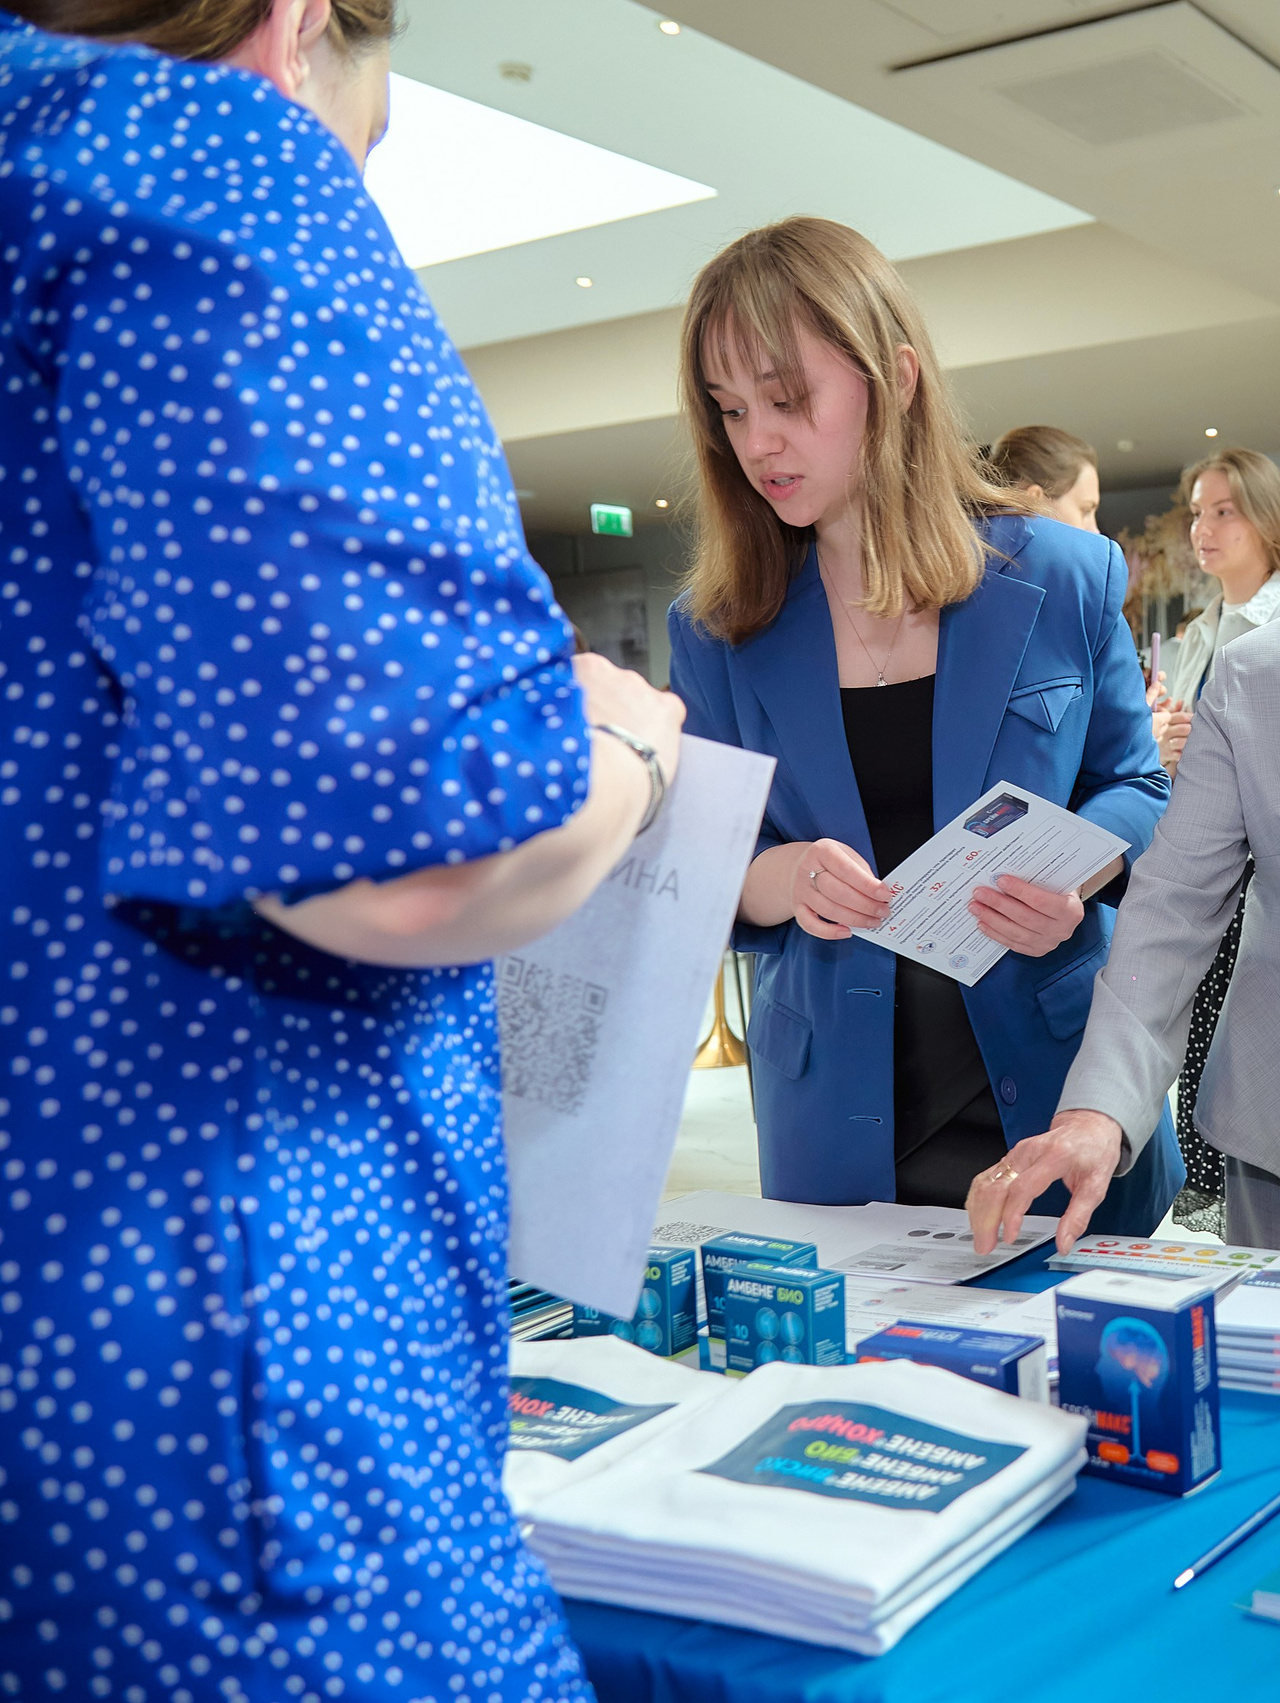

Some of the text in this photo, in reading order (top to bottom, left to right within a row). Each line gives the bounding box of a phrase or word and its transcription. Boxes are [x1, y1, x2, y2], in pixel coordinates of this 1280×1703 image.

[727, 1278, 775, 1300] АМБЕНЕ
[777, 1287, 804, 1305] БИО
[735, 1324, 749, 1339] 10
